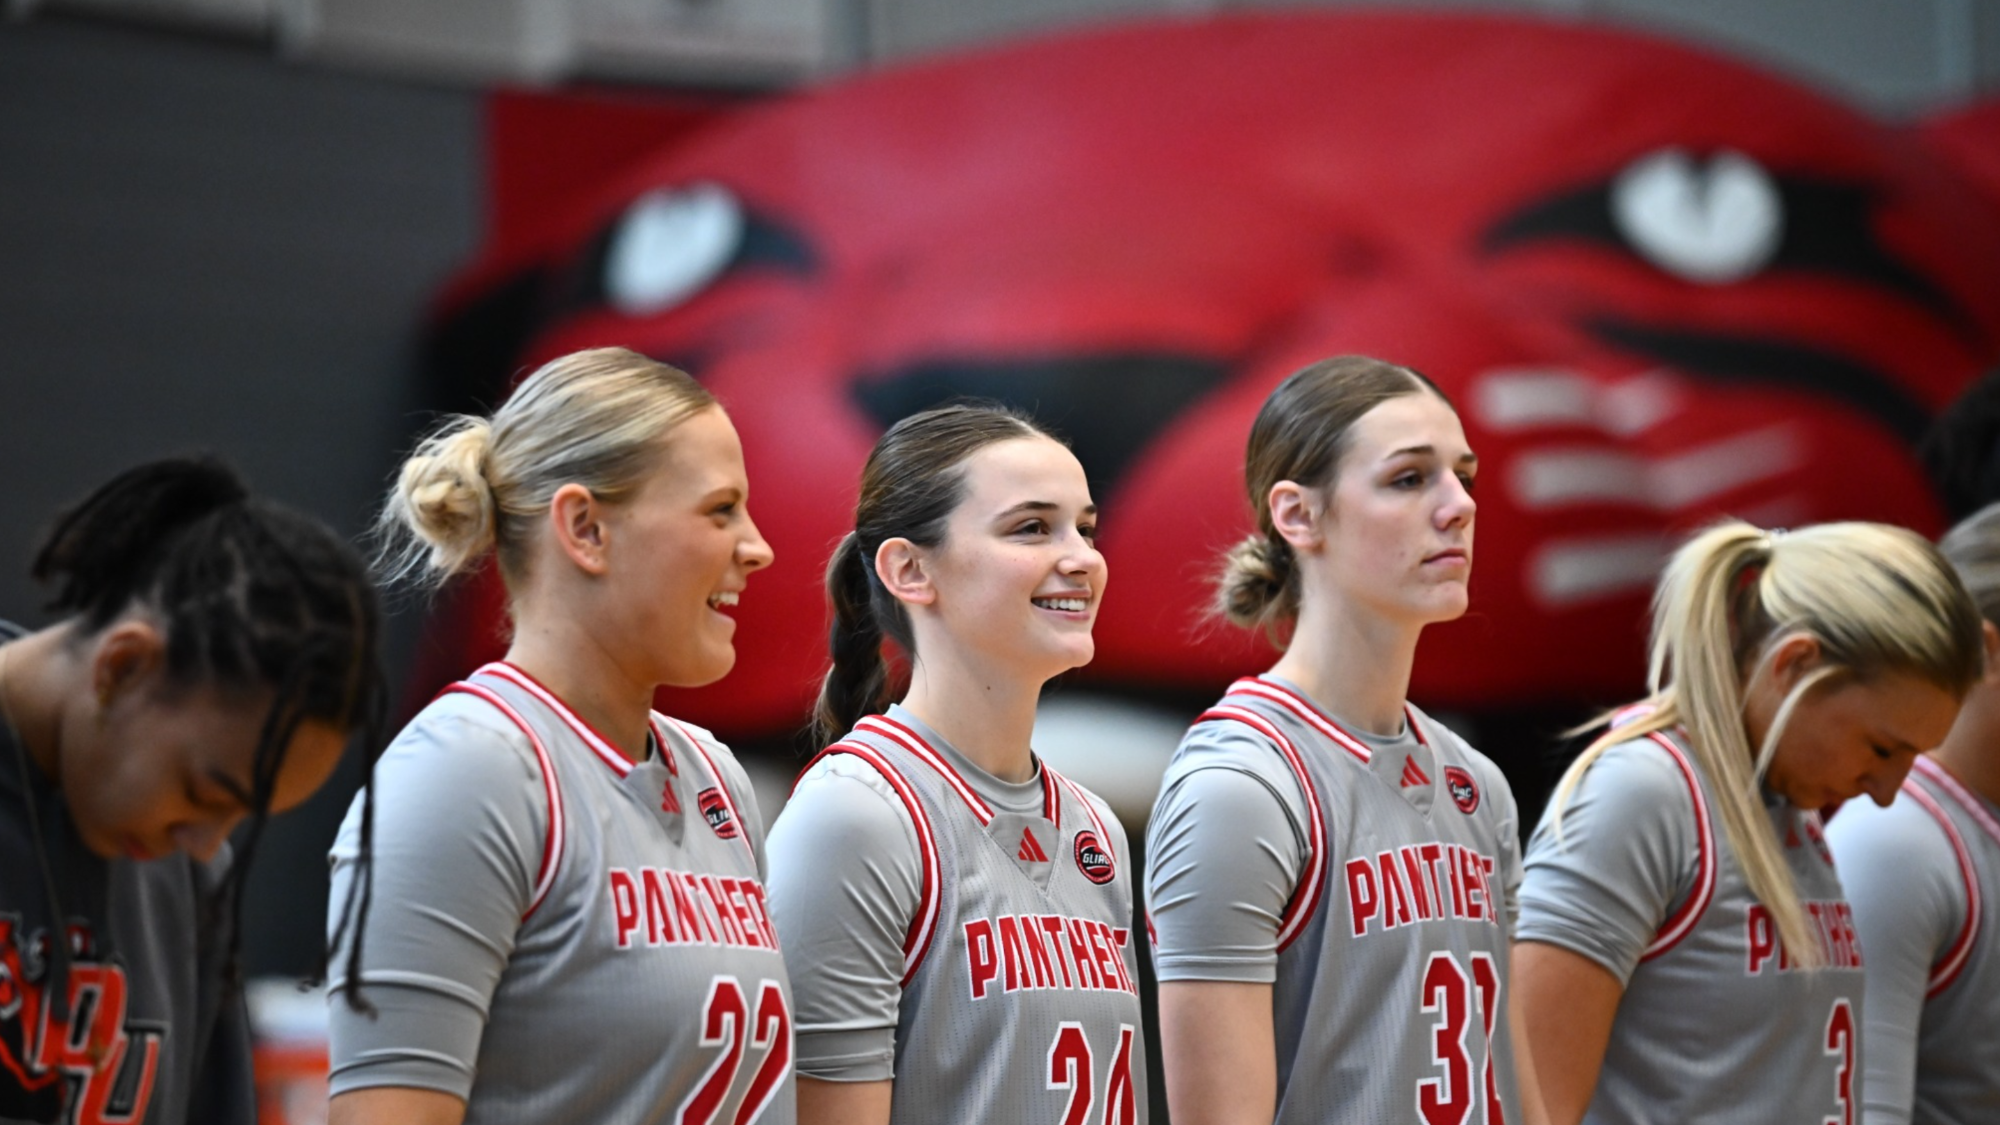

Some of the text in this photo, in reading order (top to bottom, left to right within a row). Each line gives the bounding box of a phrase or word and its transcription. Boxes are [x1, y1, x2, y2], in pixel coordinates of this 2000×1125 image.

[609, 866, 779, 954] PANTHER
[1345, 842, 1498, 938] PANTER
[963, 913, 1138, 1001] PANTHER
[676, 974, 794, 1125] 22
[1046, 1020, 1138, 1125] 24
